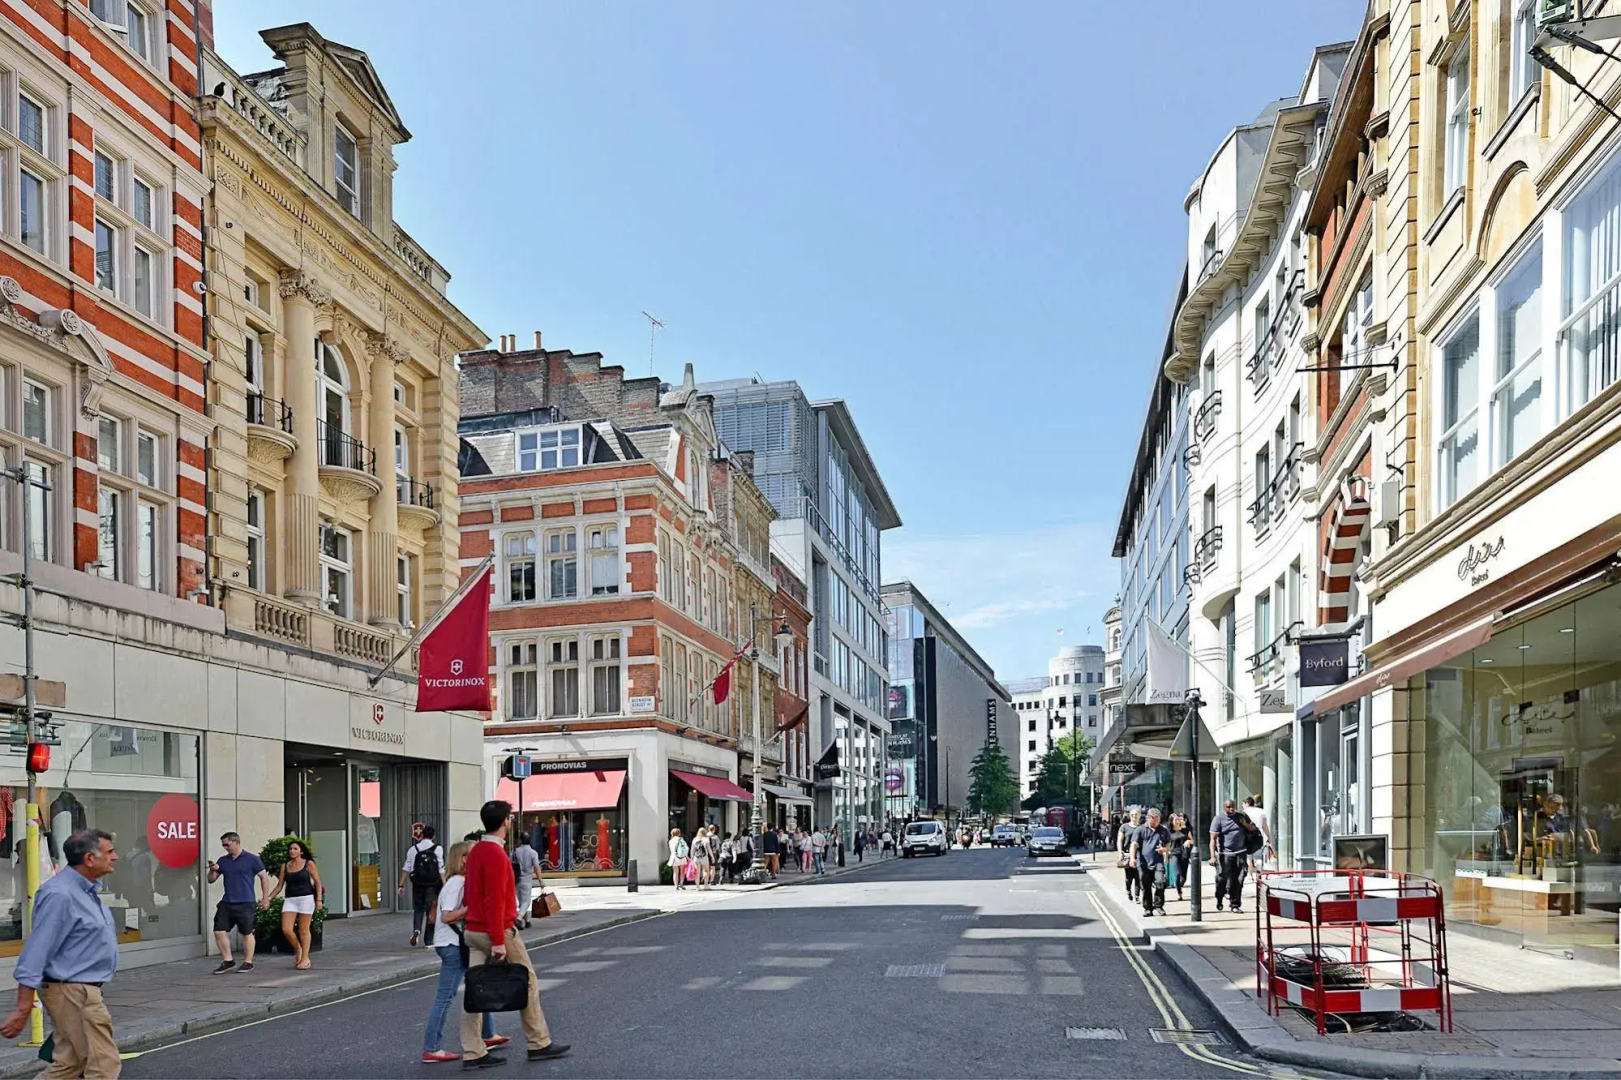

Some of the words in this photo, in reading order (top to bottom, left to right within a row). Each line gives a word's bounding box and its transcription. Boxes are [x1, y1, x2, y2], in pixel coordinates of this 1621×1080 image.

[1305, 657, 1343, 671] Byford
[425, 678, 485, 687] VICTORINOX
[1150, 689, 1181, 701] Zegna
[1262, 694, 1285, 708] Zeg
[352, 727, 404, 745] VICTORINOX
[541, 762, 587, 770] PRONOVIAS
[1110, 763, 1136, 771] next
[157, 821, 197, 839] SALE
